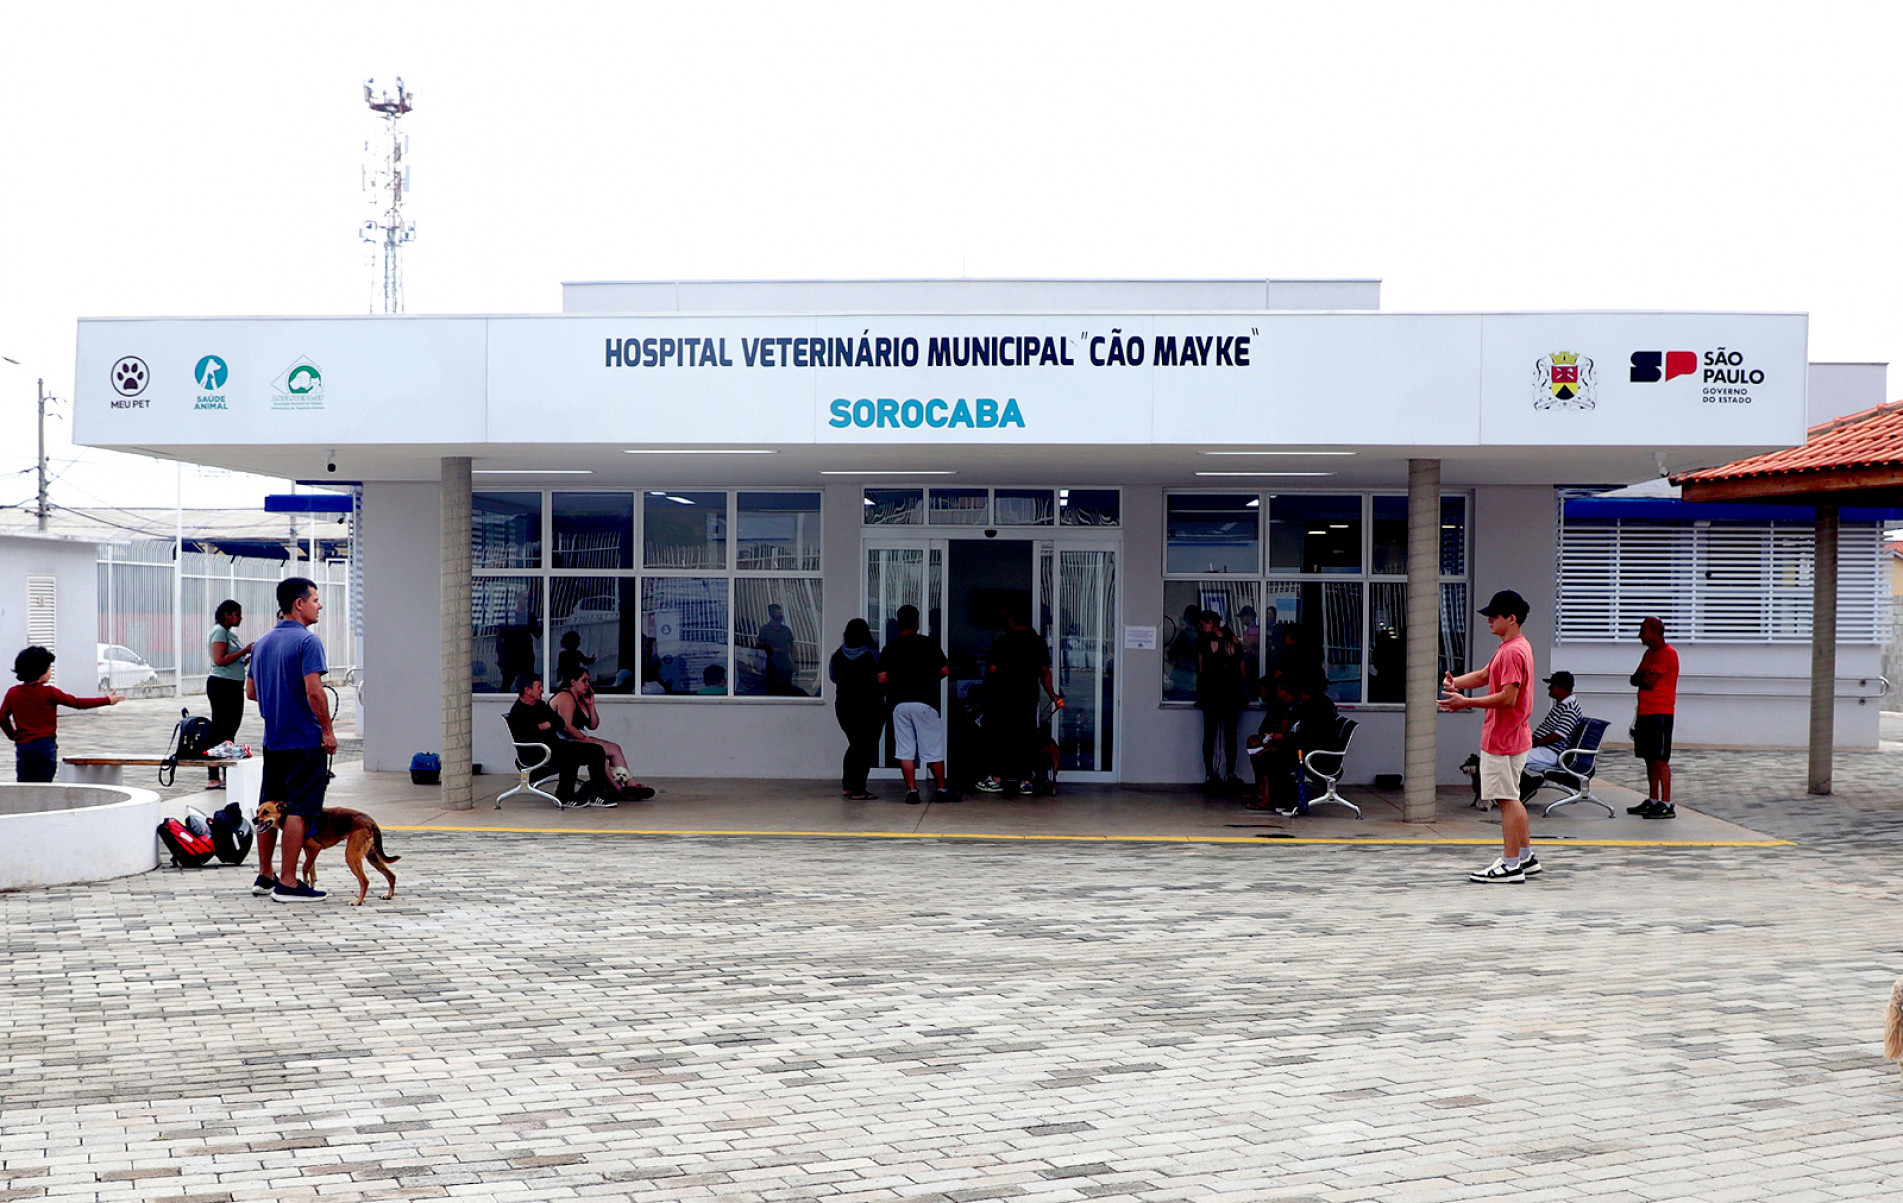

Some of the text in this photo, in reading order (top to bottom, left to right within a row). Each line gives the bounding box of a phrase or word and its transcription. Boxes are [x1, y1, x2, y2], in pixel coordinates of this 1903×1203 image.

[605, 337, 734, 368] HOSPITAL
[740, 328, 920, 368] VETERINÁRIO
[927, 335, 1075, 367] MUNICIPAL
[1703, 346, 1744, 367] SÃO
[1629, 350, 1698, 383] SP
[1703, 368, 1765, 385] PAULO
[1702, 387, 1748, 396] GOVERNO
[110, 399, 151, 409] MEU PET
[196, 394, 226, 403] SAÚDE
[1702, 396, 1752, 404] DO ESTADO
[193, 402, 229, 410] ANIMAL
[828, 397, 1027, 429] SOROCABA
